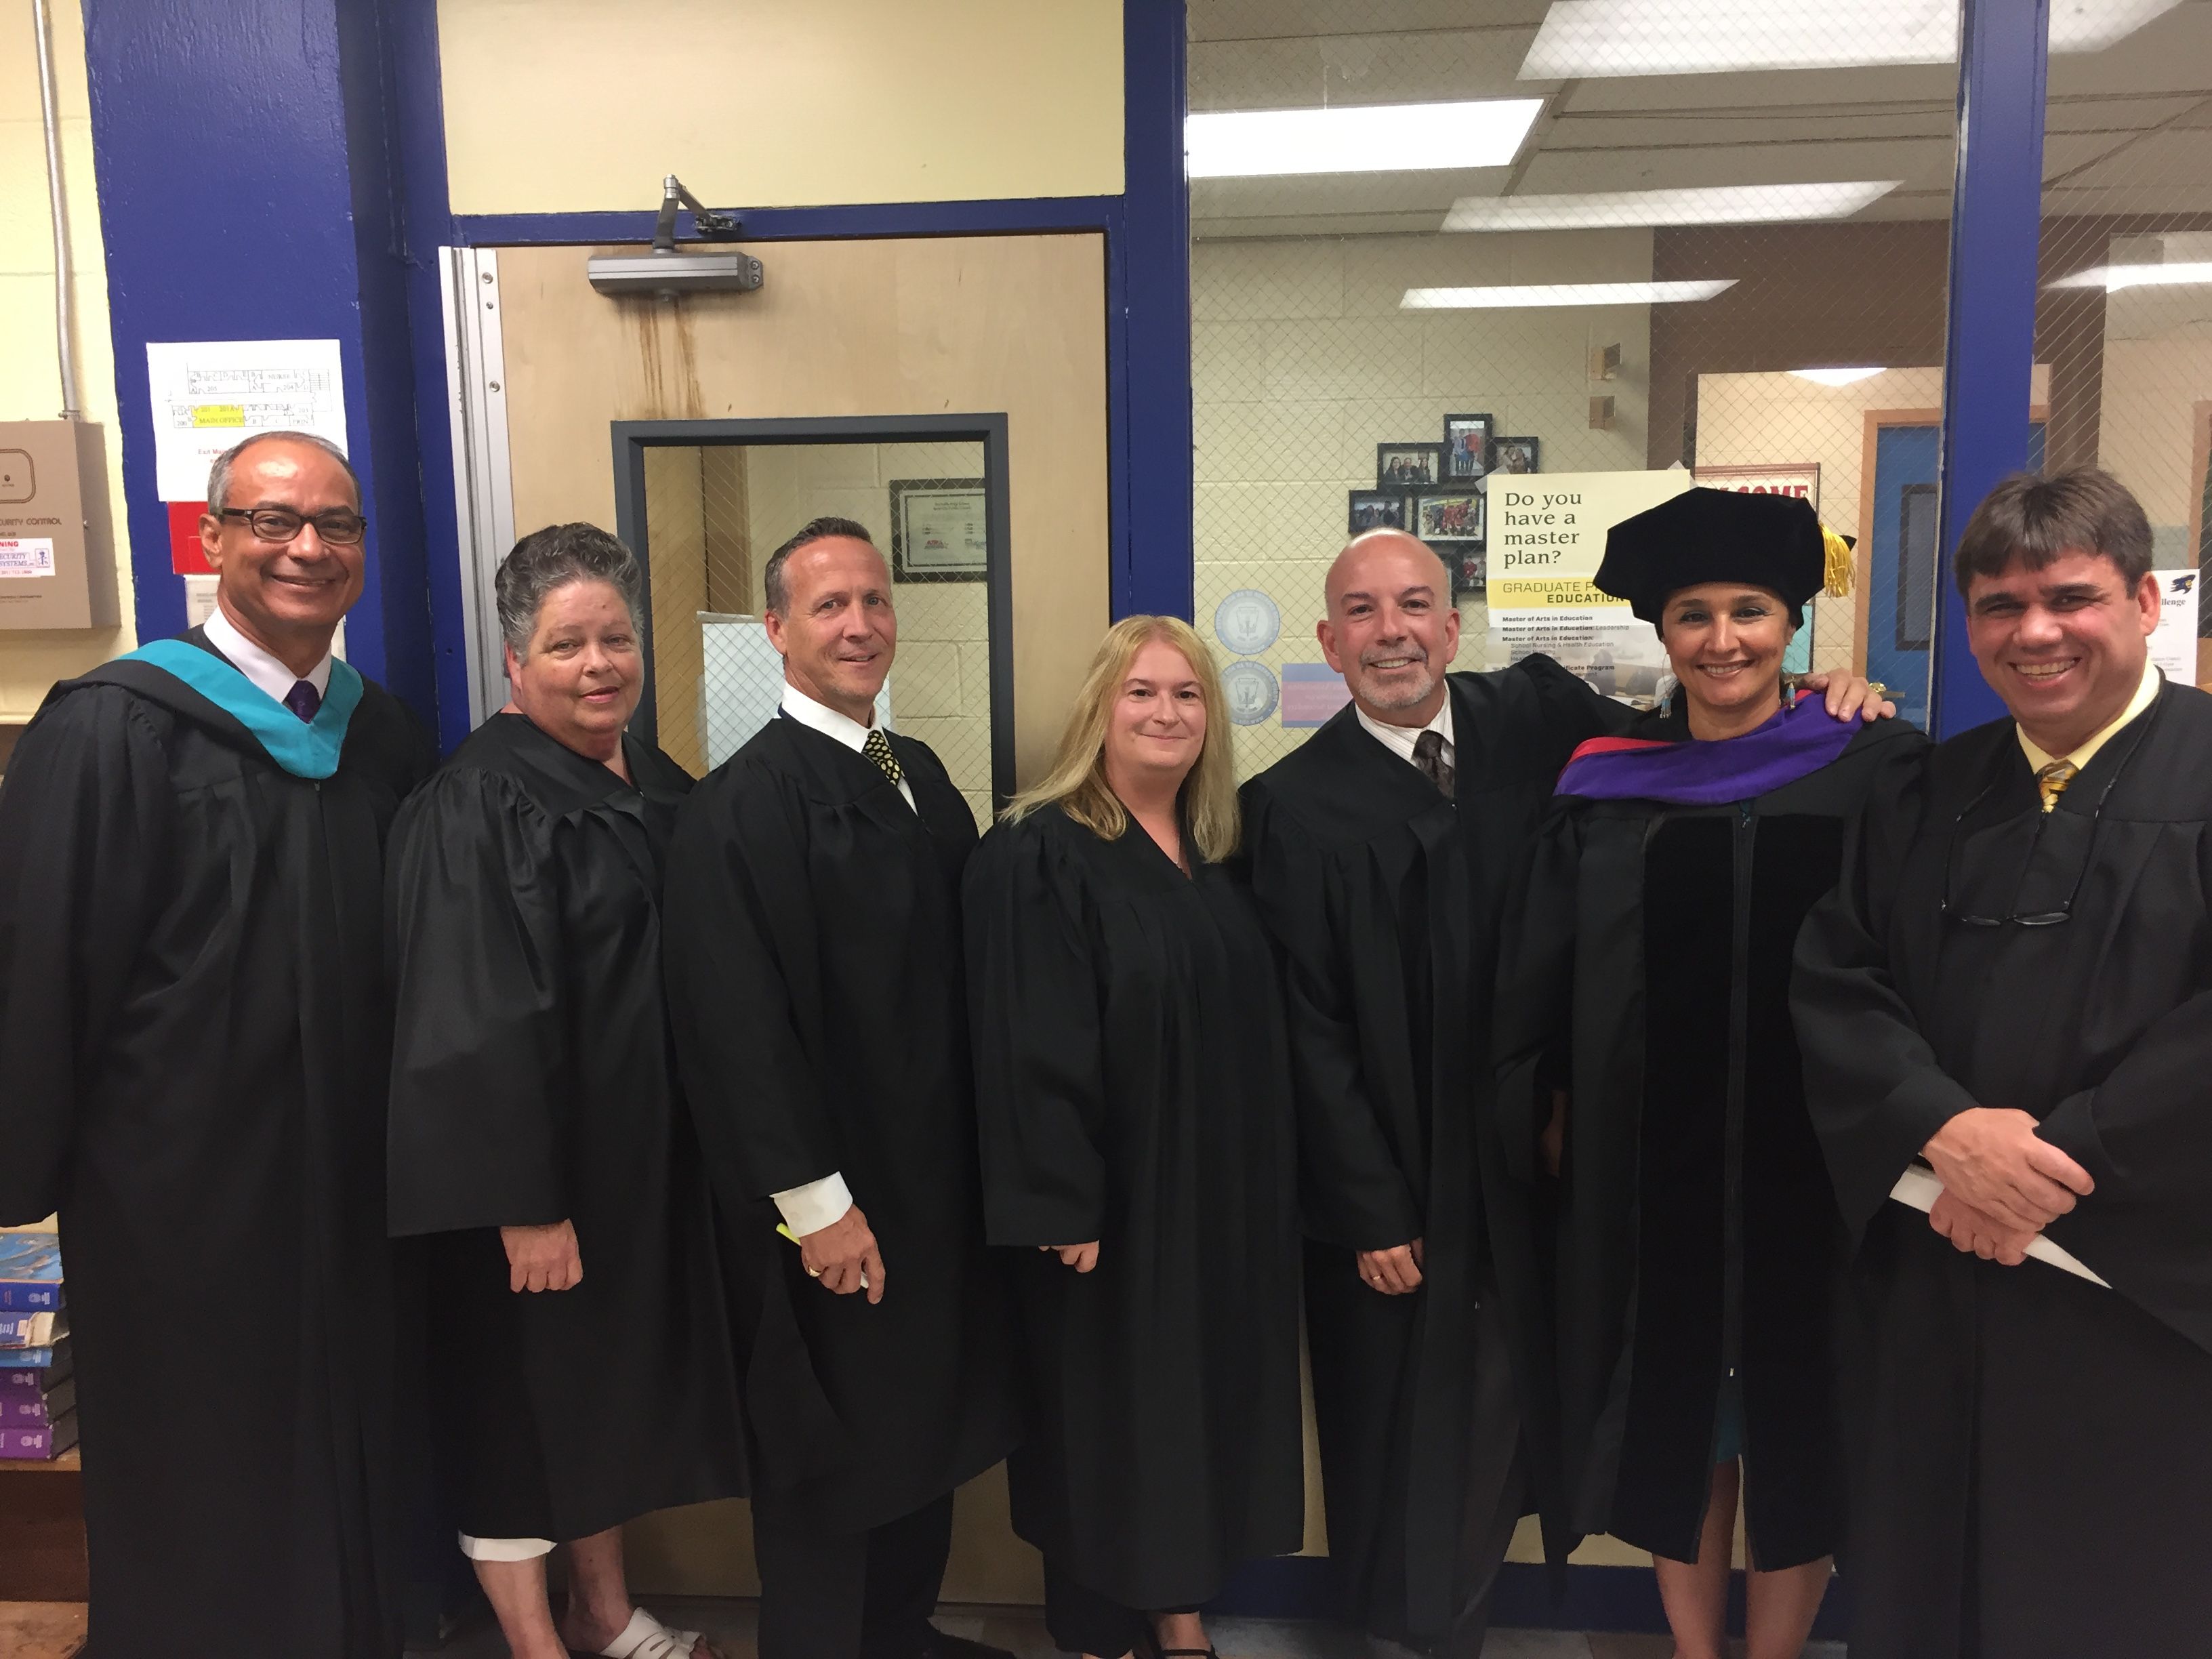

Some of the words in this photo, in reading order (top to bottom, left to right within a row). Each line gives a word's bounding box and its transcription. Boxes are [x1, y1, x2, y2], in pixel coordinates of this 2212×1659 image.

[1505, 493, 1534, 506] Do
[1542, 493, 1582, 510] you
[26, 517, 62, 526] CONTROL
[1504, 511, 1555, 526] have
[1564, 513, 1576, 525] a
[1504, 531, 1580, 546] master
[1504, 550, 1561, 569] plan?
[1502, 581, 1580, 593] GRADUATE
[1585, 581, 1598, 592] P
